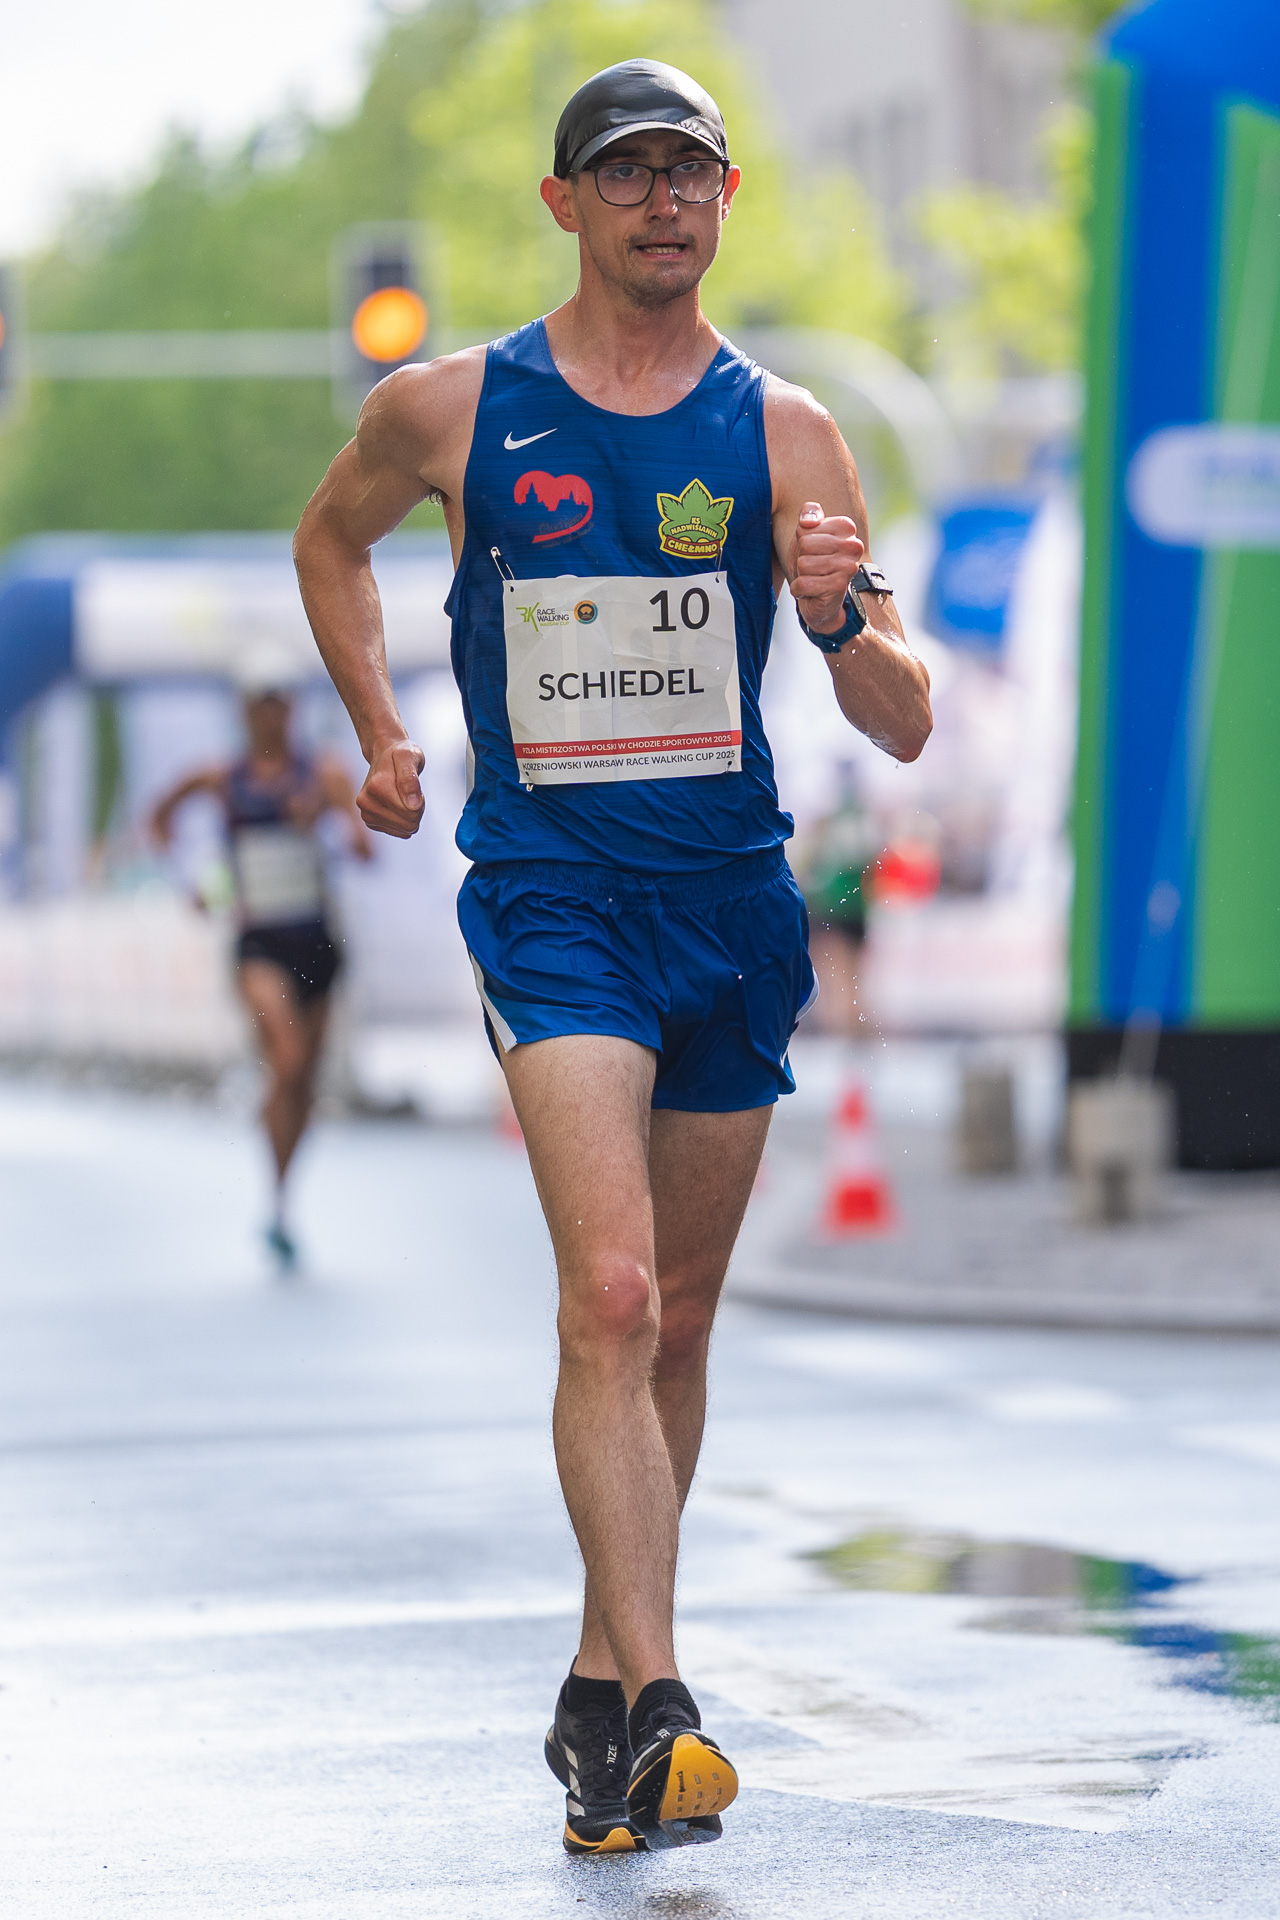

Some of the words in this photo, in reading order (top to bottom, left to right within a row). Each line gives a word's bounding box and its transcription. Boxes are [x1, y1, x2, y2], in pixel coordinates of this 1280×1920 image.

[537, 614, 570, 622] WALKING
[649, 587, 710, 632] 10
[538, 667, 705, 701] SCHIEDEL
[536, 745, 591, 753] MISTRZOSTWA
[591, 743, 617, 751] POLSKI
[618, 742, 626, 750] W
[627, 740, 661, 749] CHODZIE
[662, 737, 712, 747] SPORTOWYM
[713, 734, 732, 743] 2025
[522, 761, 582, 771] KORZENIOWSKI
[583, 759, 625, 769] WARSAW
[626, 757, 650, 766] RACE
[651, 754, 694, 764] WALKING
[695, 752, 714, 761] CUP
[715, 750, 736, 759] 2025
